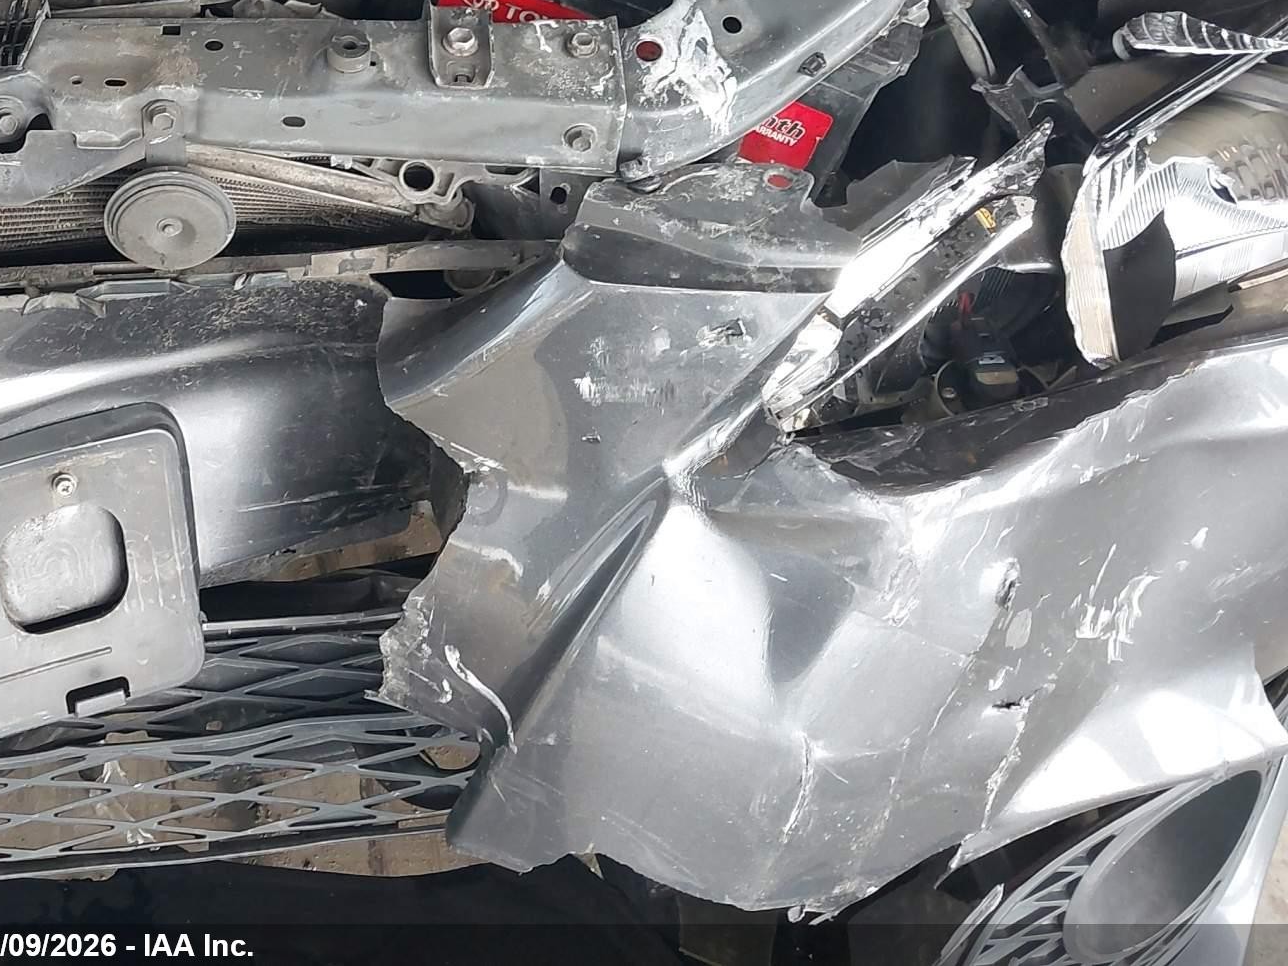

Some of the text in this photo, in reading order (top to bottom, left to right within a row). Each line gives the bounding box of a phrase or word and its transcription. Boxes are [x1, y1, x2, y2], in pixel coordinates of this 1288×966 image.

[505, 2, 549, 23] TO
[755, 123, 799, 147] ARRANTY
[761, 115, 806, 141] nth
